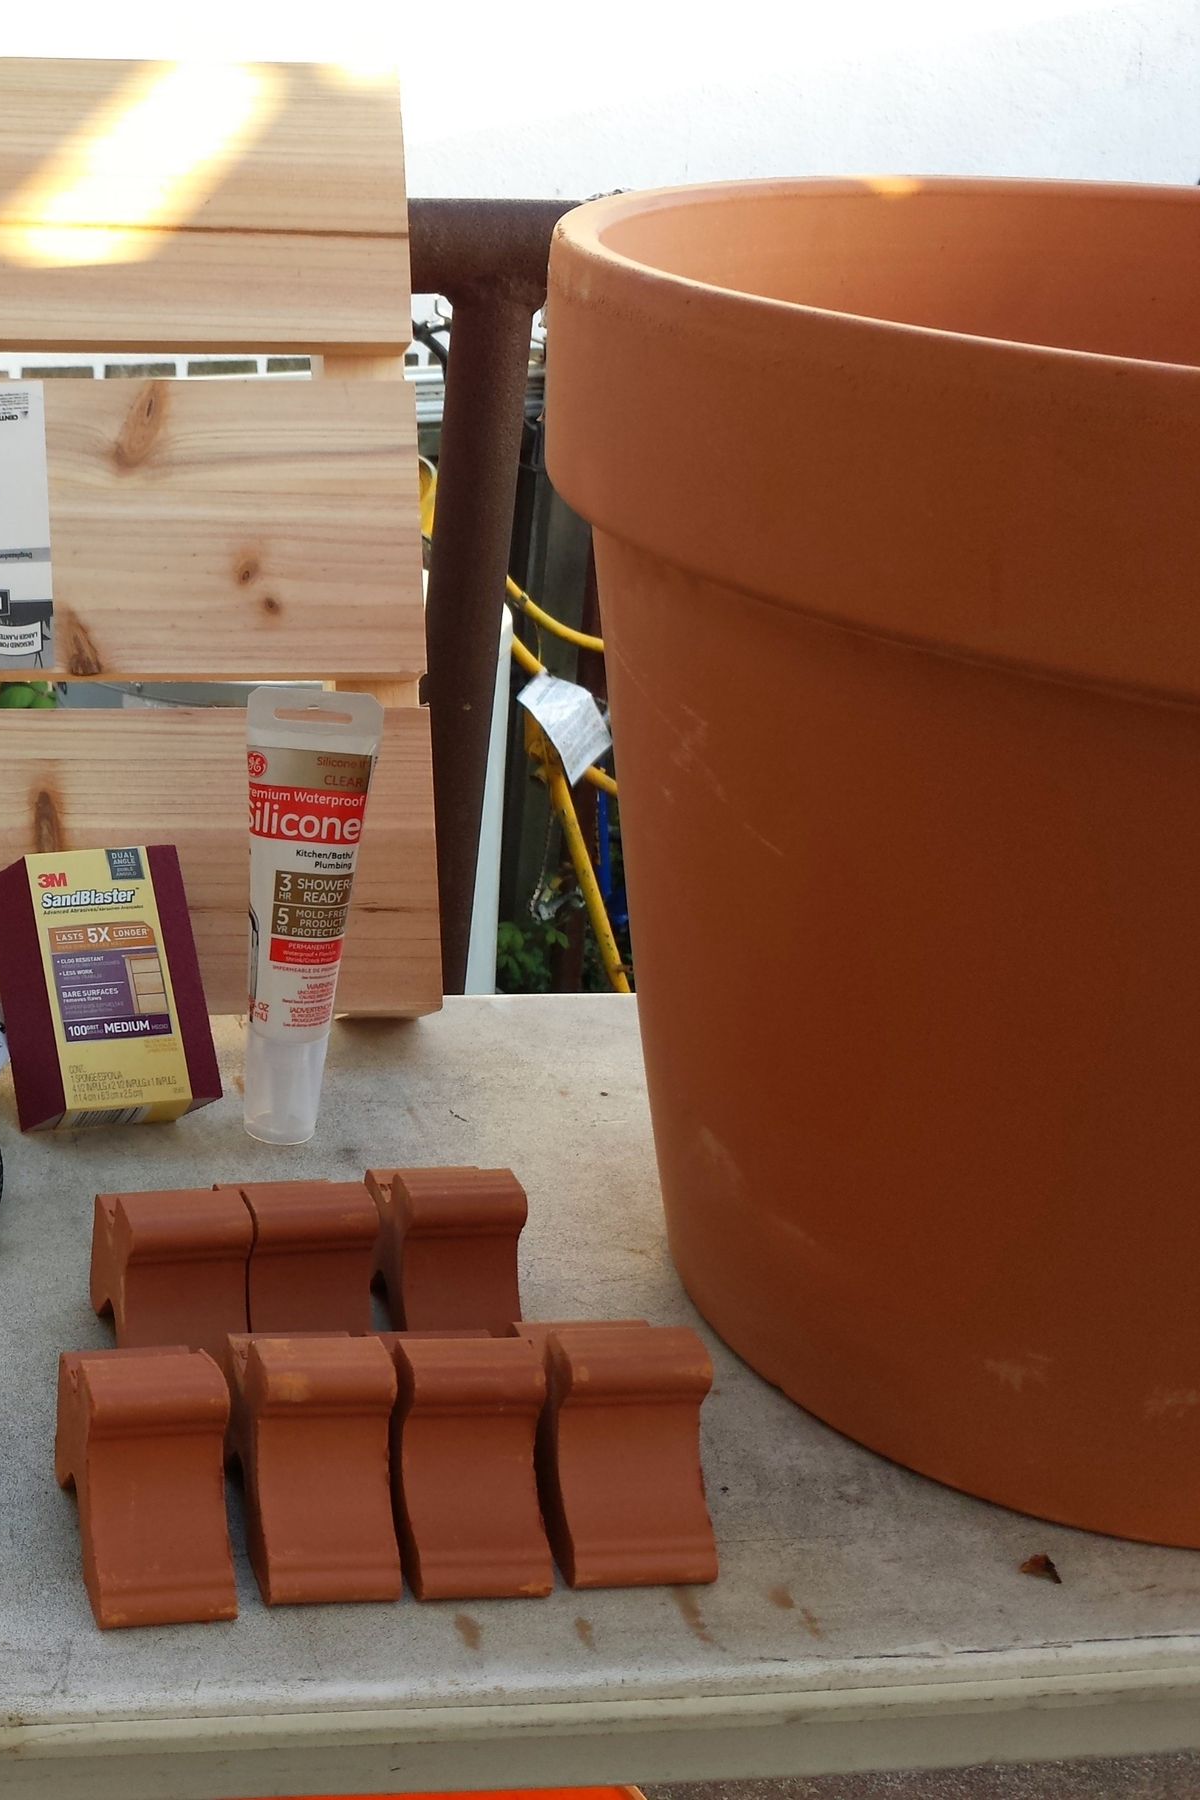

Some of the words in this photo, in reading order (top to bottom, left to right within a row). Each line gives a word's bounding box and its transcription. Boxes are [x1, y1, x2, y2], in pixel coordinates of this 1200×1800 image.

[20, 631, 37, 640] LARGER
[324, 775, 363, 787] CLEAR
[249, 787, 291, 801] emium
[293, 791, 365, 808] Waterproof
[111, 851, 134, 859] DUAL
[113, 858, 136, 866] ANGLE
[314, 861, 352, 871] Plumbing
[37, 872, 68, 888] 3M
[279, 874, 292, 892] 3
[42, 887, 135, 909] SandBlaster
[278, 891, 292, 901] HR
[303, 891, 343, 904] READY
[43, 907, 69, 915] Advanced
[277, 908, 289, 925] 5
[296, 909, 347, 920] MOLD-FREE
[300, 919, 343, 928] PRODUCT
[55, 932, 84, 942] LASTS
[87, 927, 111, 943] 5X
[113, 928, 148, 938] LONGER
[276, 925, 288, 935] YR
[291, 926, 344, 937] PROTECTION
[288, 942, 334, 950] PERMANENTLY
[62, 990, 81, 998] BARE
[82, 987, 119, 997] SURFACES
[68, 1025, 87, 1037] 100
[104, 1020, 150, 1034] MEDIUM
